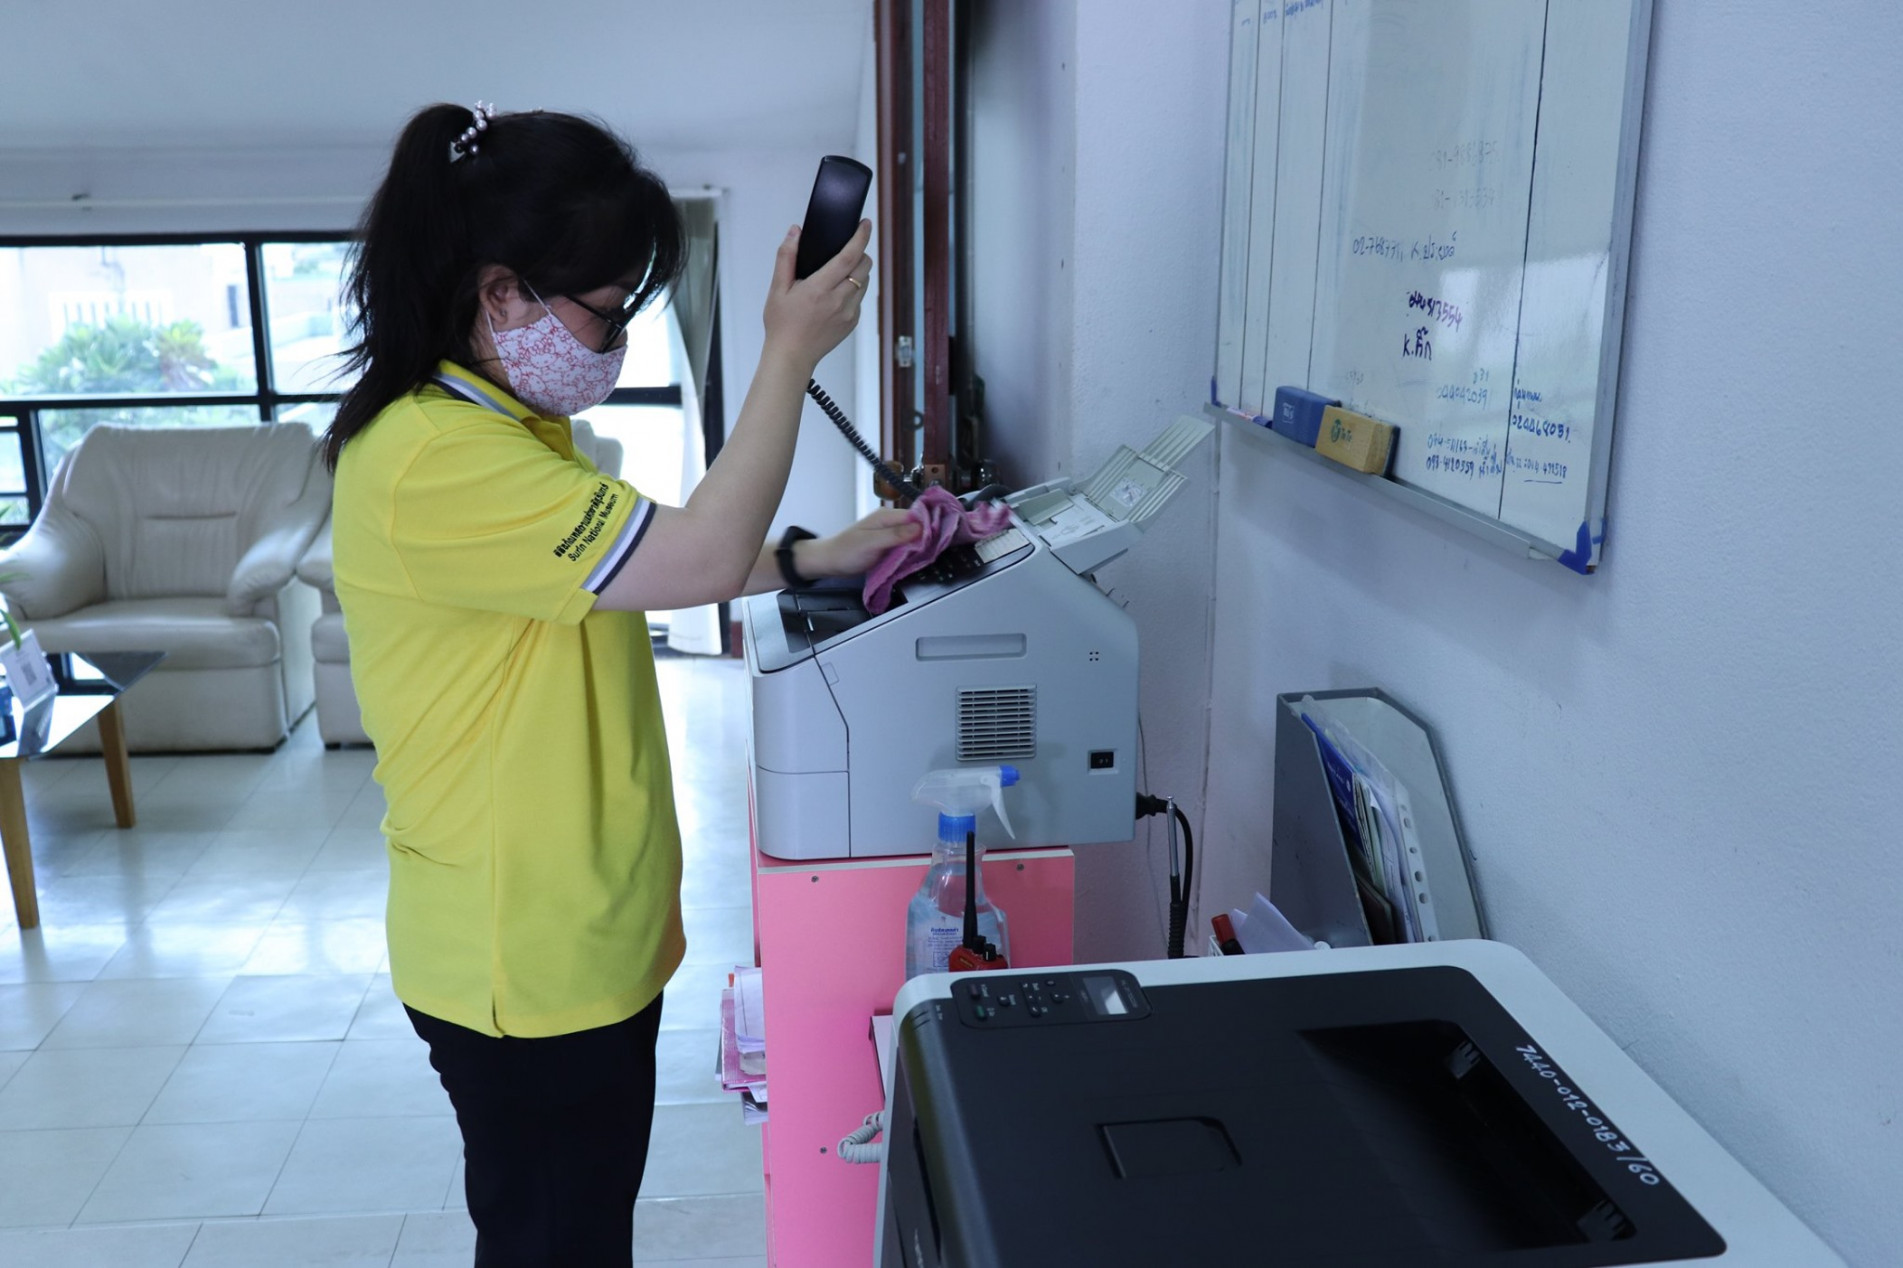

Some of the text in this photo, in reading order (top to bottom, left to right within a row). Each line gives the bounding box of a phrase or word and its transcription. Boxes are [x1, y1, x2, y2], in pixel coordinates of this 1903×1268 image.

[568, 493, 619, 562] Surin National Museum
[1515, 1044, 1660, 1186] 7440-012-0183/60
